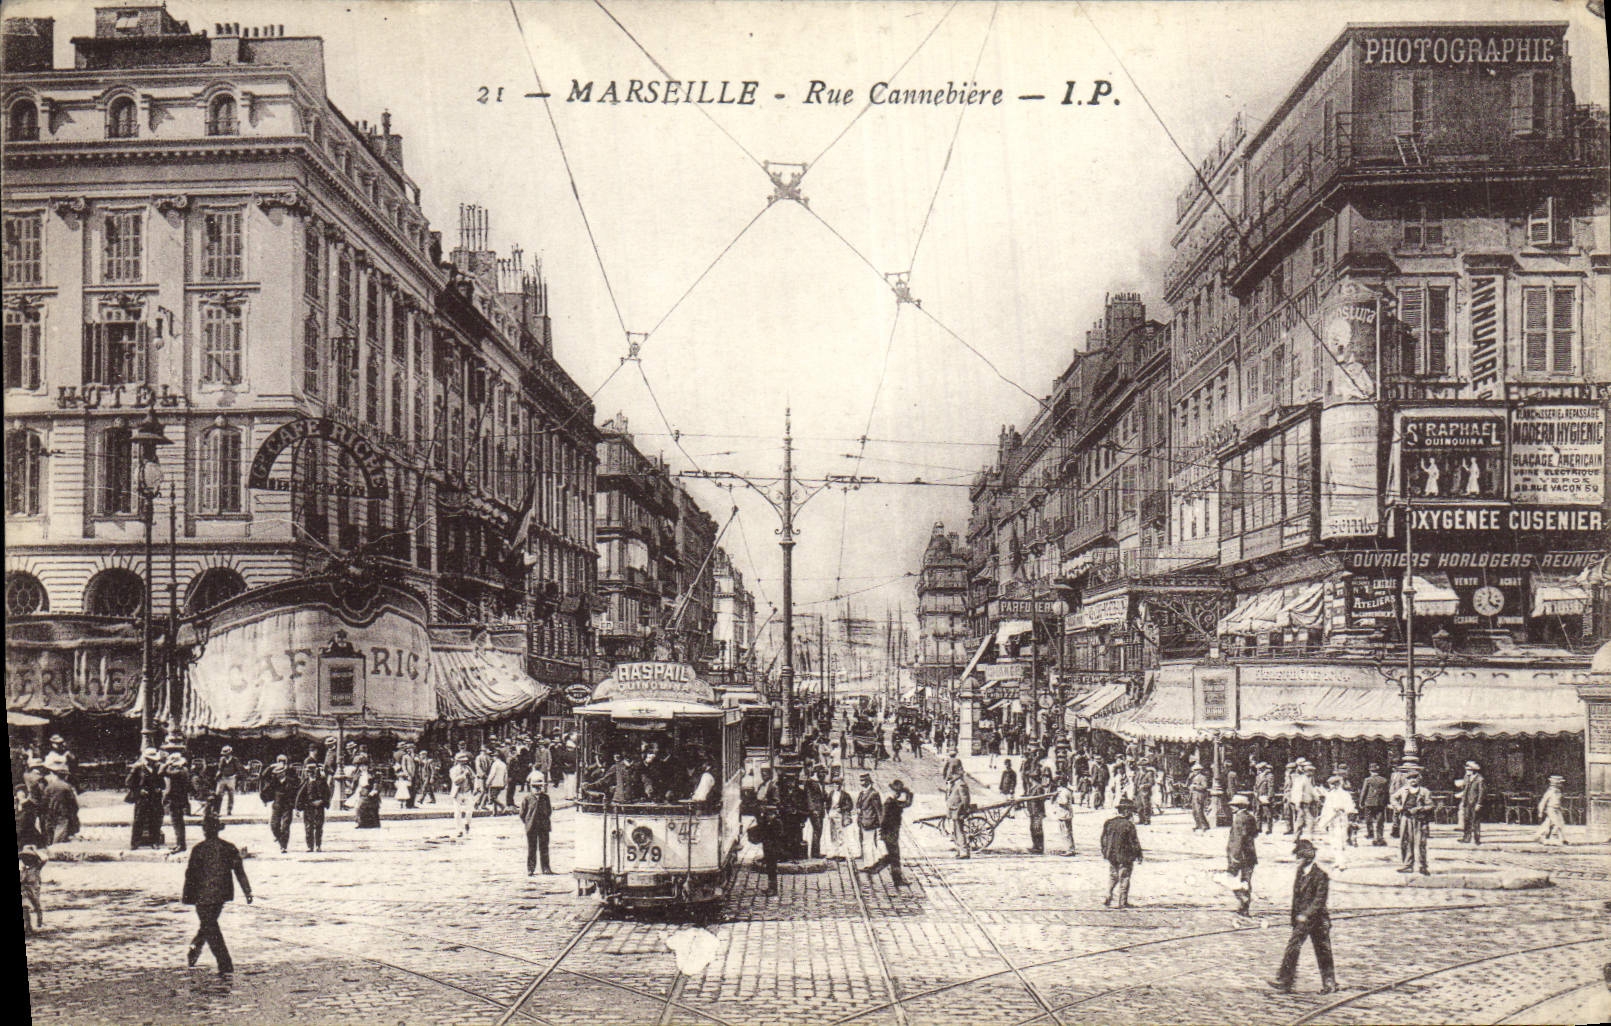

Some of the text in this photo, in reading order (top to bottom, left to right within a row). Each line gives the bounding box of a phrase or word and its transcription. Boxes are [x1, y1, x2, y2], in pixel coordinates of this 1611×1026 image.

[1364, 37, 1555, 64] PHOTOGRAPHIE
[1509, 511, 1602, 530] CUSENIER
[1353, 553, 1431, 567] OUVRIERS
[1438, 552, 1533, 567] HORLOGERS
[626, 845, 663, 863] 579
